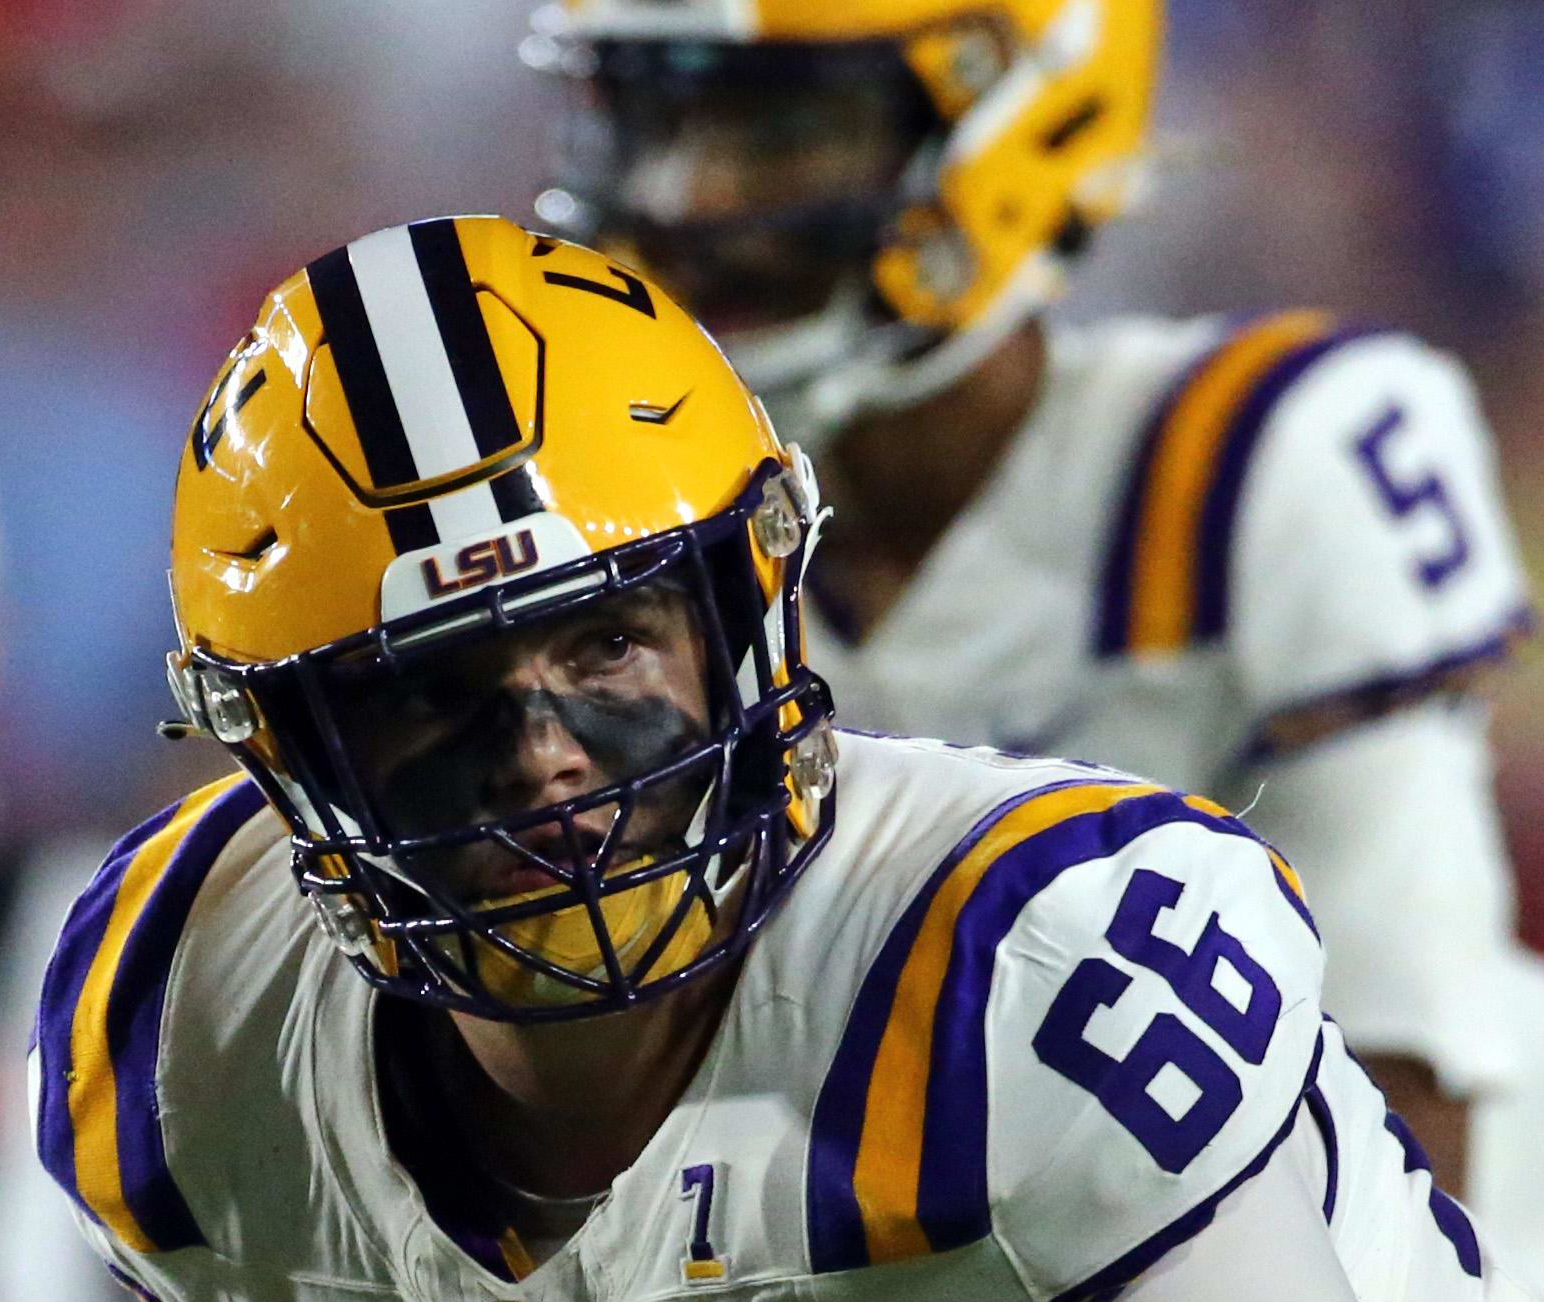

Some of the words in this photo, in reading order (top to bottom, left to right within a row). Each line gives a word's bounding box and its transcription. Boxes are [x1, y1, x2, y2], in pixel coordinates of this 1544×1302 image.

[420, 529, 539, 600] LSU
[1358, 405, 1471, 589] 5
[1032, 868, 1282, 1175] 66
